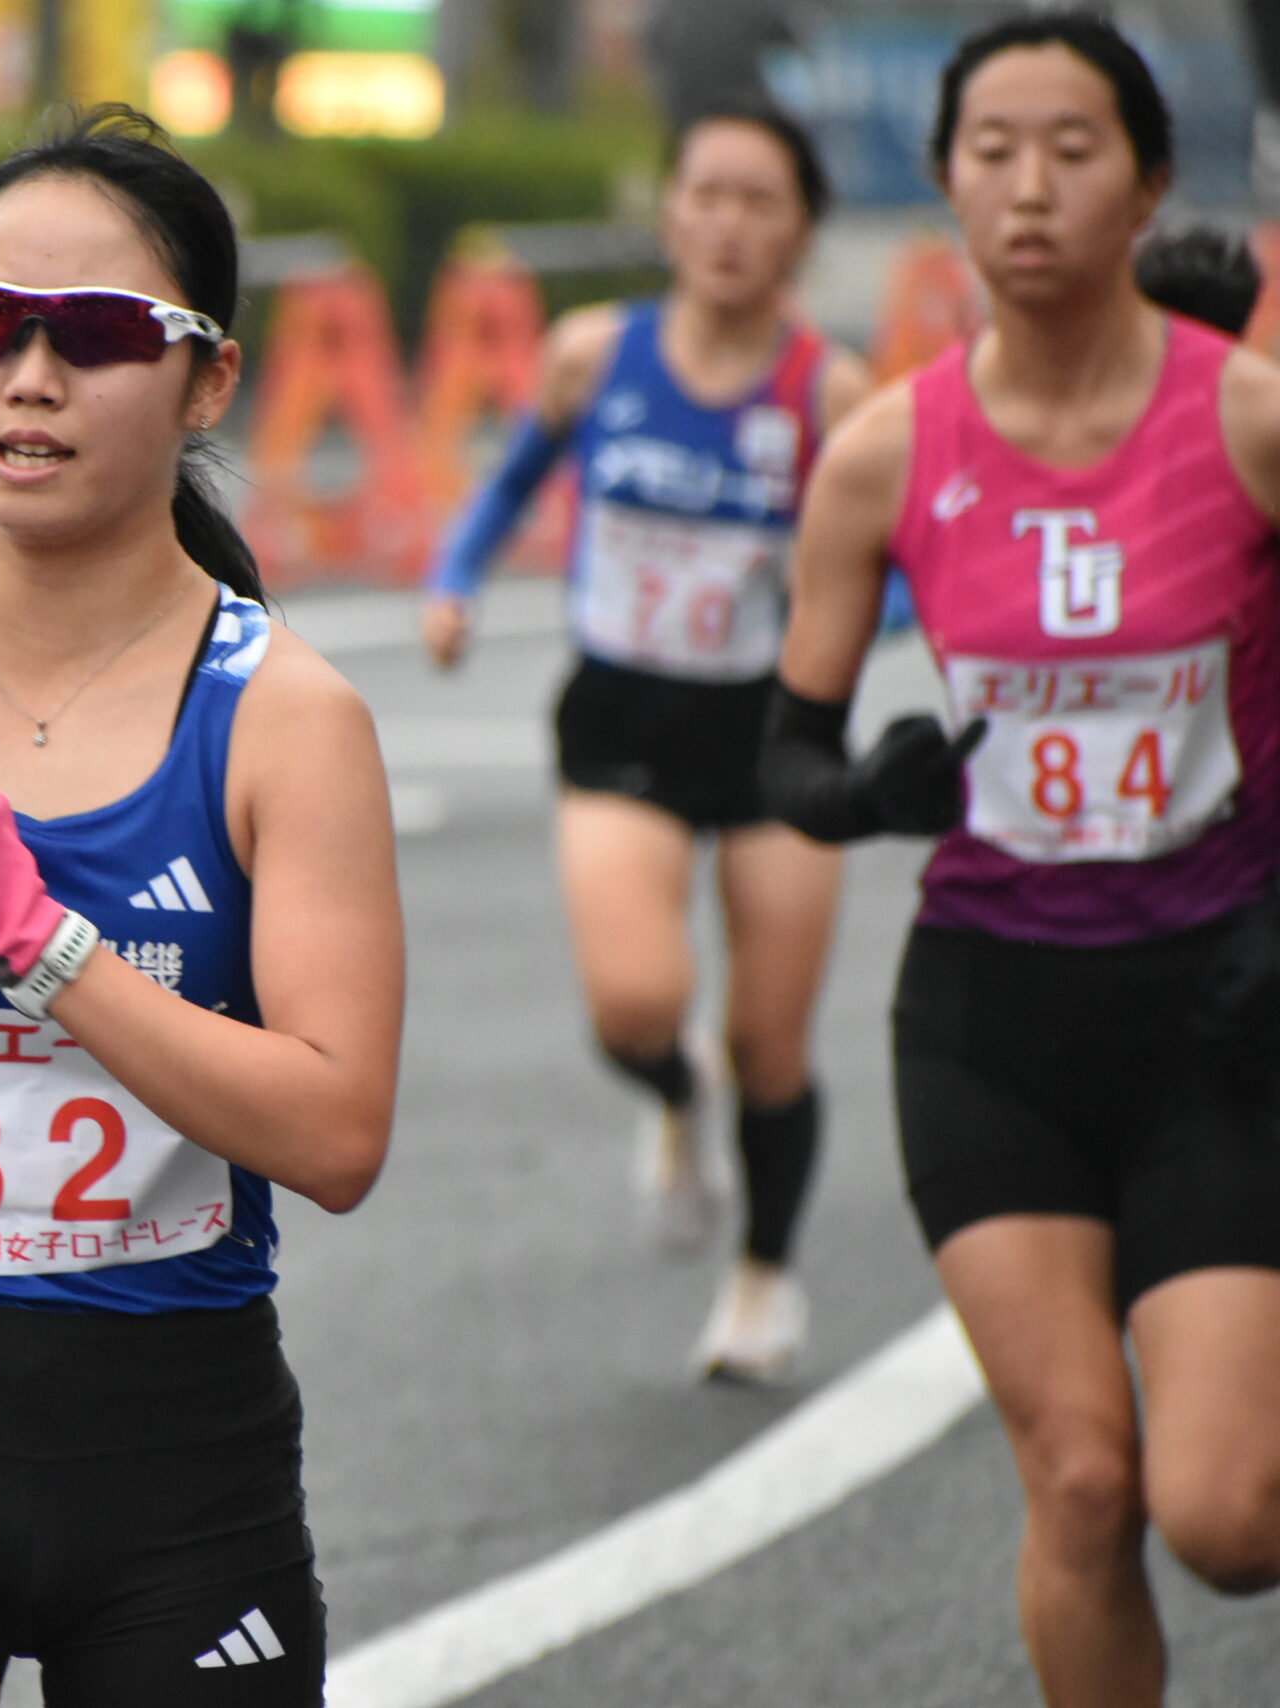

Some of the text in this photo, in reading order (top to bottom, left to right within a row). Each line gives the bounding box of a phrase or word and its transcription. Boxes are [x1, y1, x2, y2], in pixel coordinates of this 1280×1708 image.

[969, 661, 1214, 717] エリエール
[1031, 728, 1172, 821] 84
